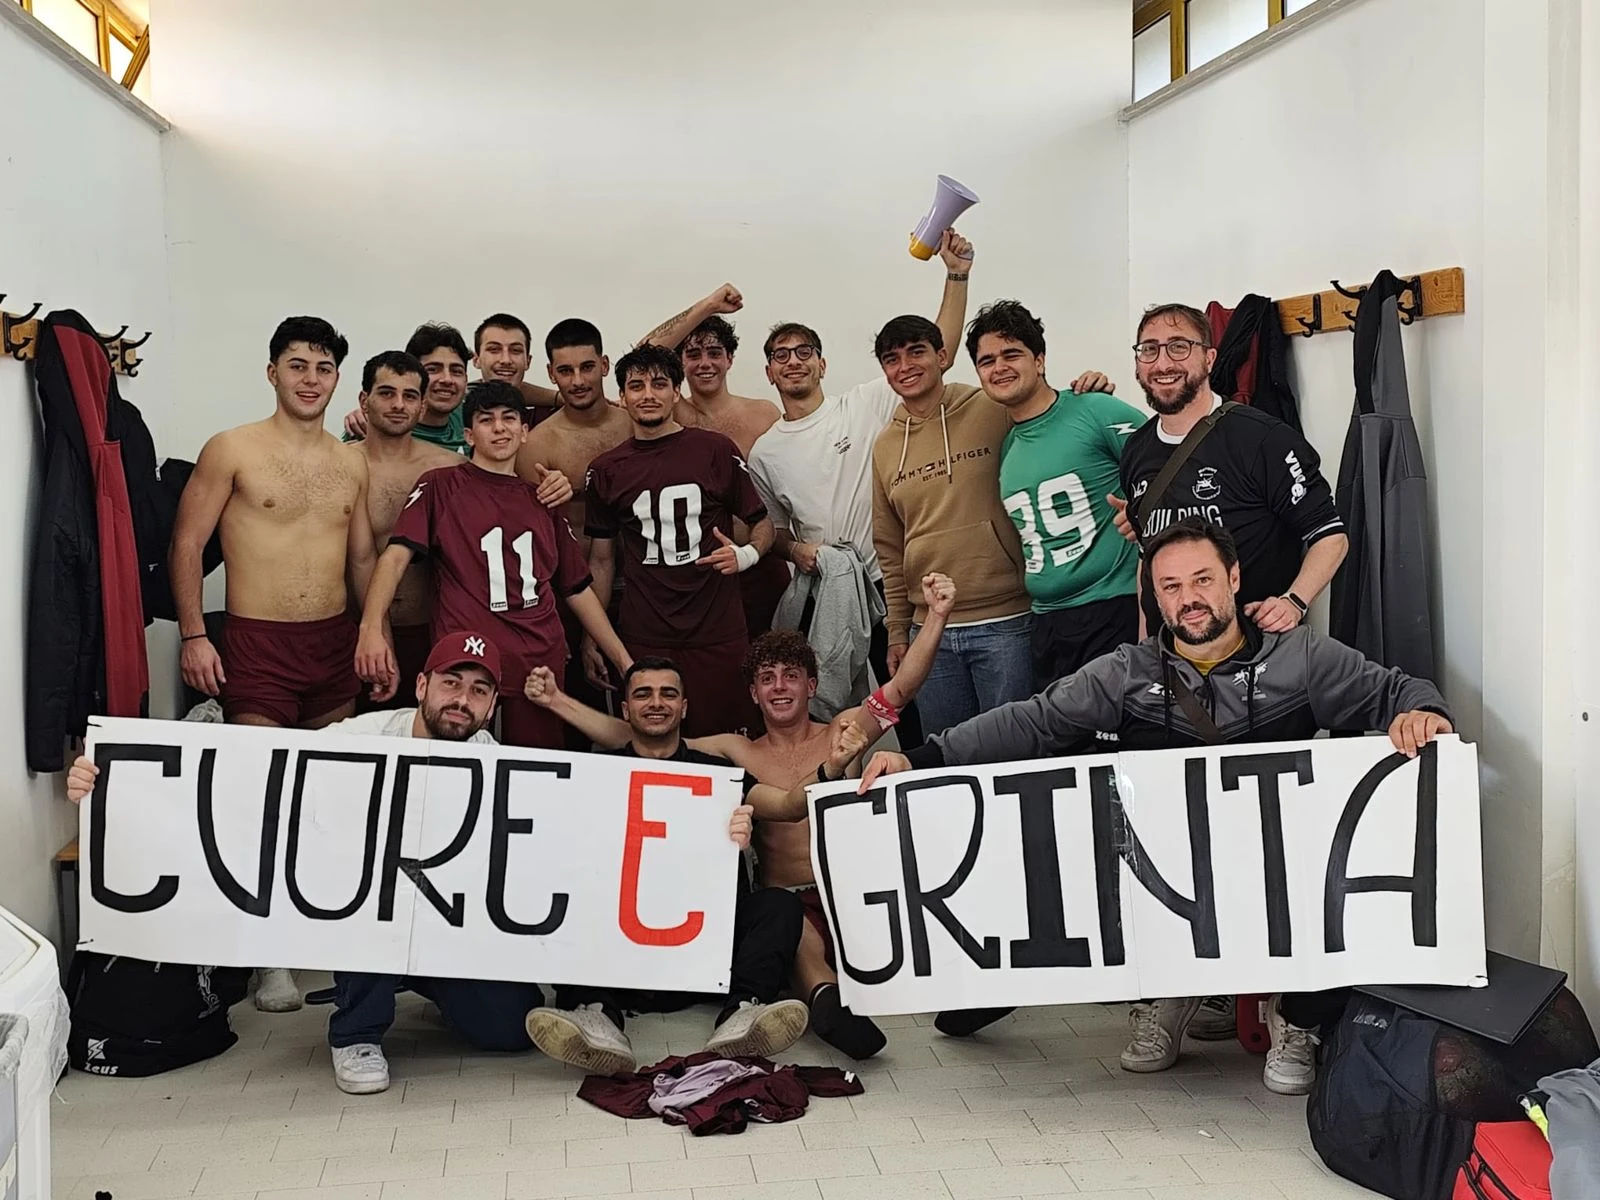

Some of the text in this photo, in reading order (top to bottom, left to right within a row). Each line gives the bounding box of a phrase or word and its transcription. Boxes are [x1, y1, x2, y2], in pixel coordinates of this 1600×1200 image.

[938, 447, 992, 468] HLFIGER
[632, 483, 703, 566] 10
[480, 526, 540, 612] 11
[463, 636, 486, 657] NY
[618, 770, 713, 947] E
[814, 740, 1438, 986] GRINTA
